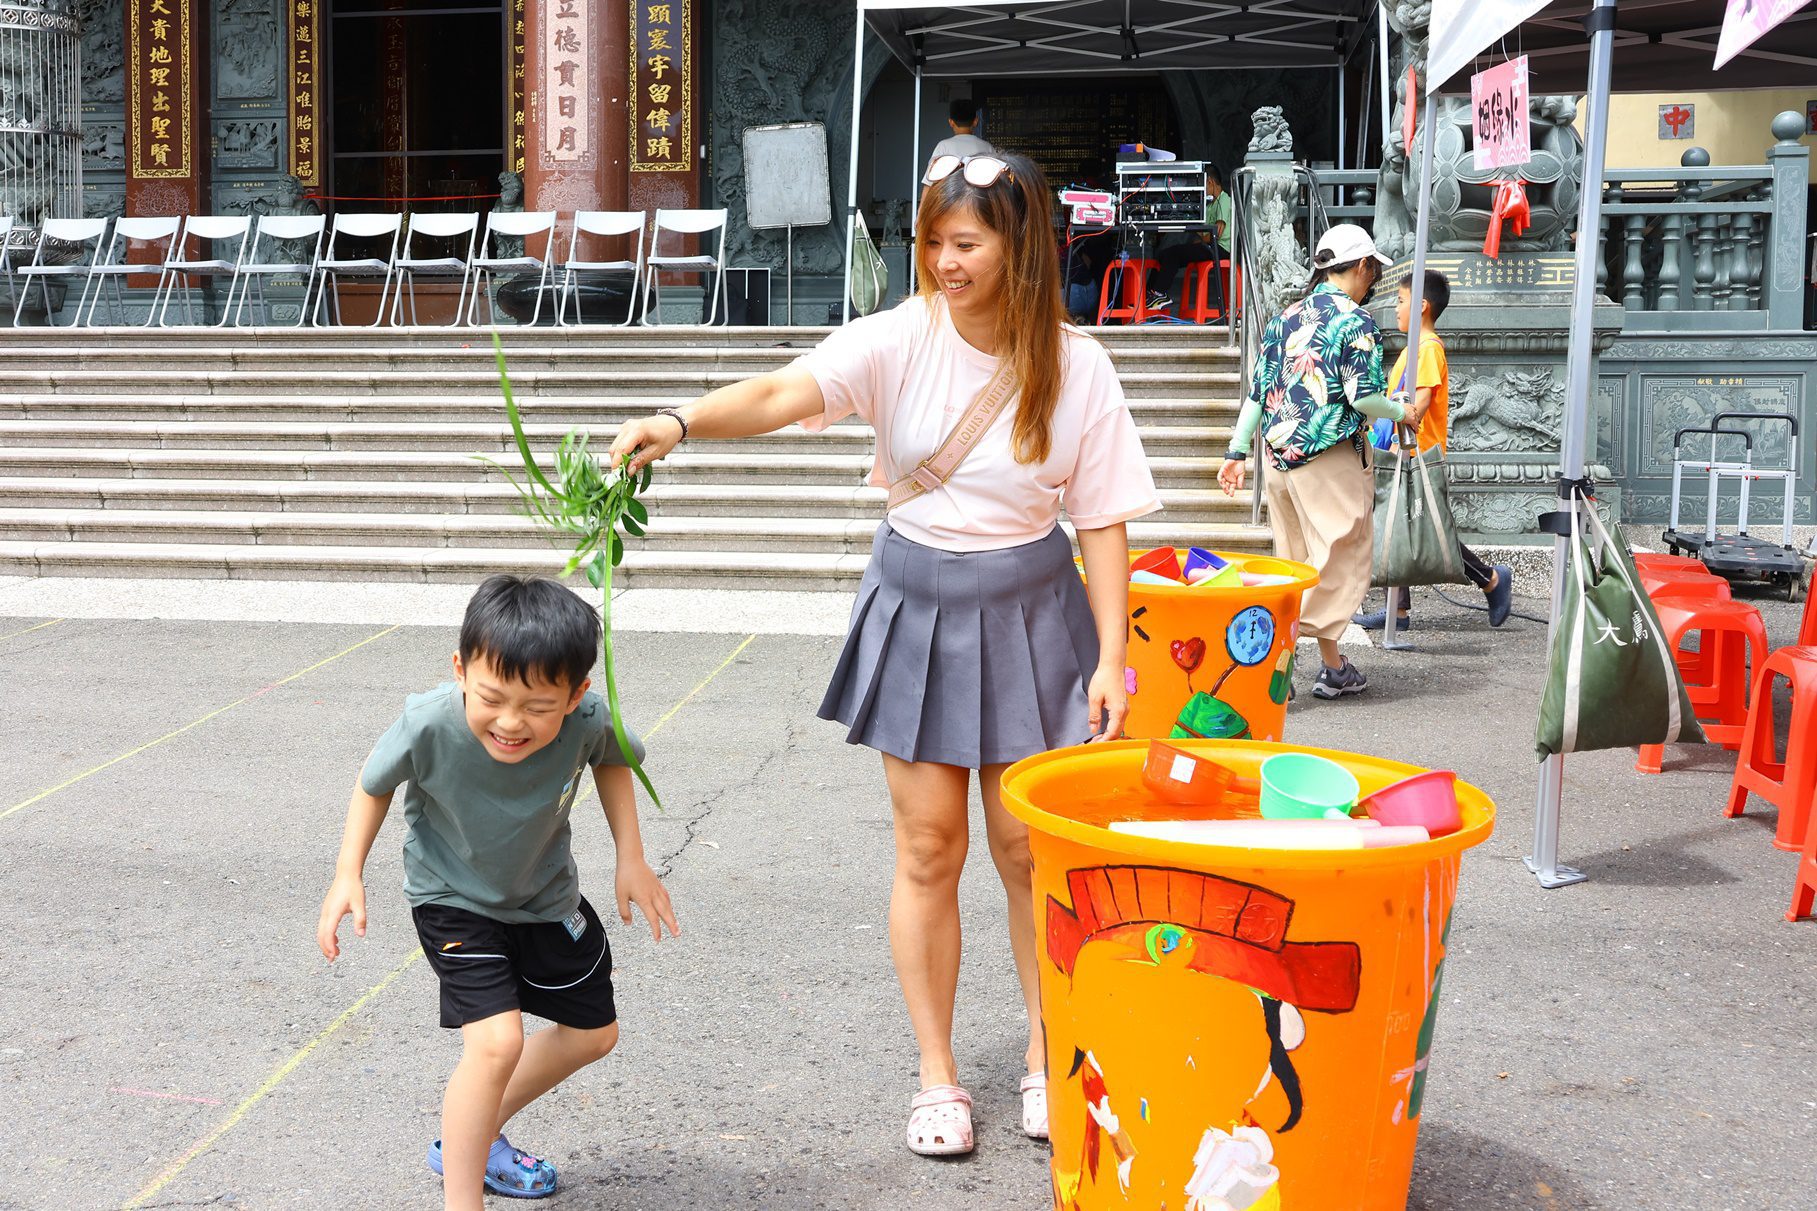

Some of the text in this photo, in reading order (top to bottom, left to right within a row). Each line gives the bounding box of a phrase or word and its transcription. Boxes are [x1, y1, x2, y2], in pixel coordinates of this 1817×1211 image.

[1479, 86, 1518, 146] 姻緣水
[1663, 105, 1691, 138] 中
[957, 415, 984, 446] LOUIS
[1248, 609, 1258, 618] 12
